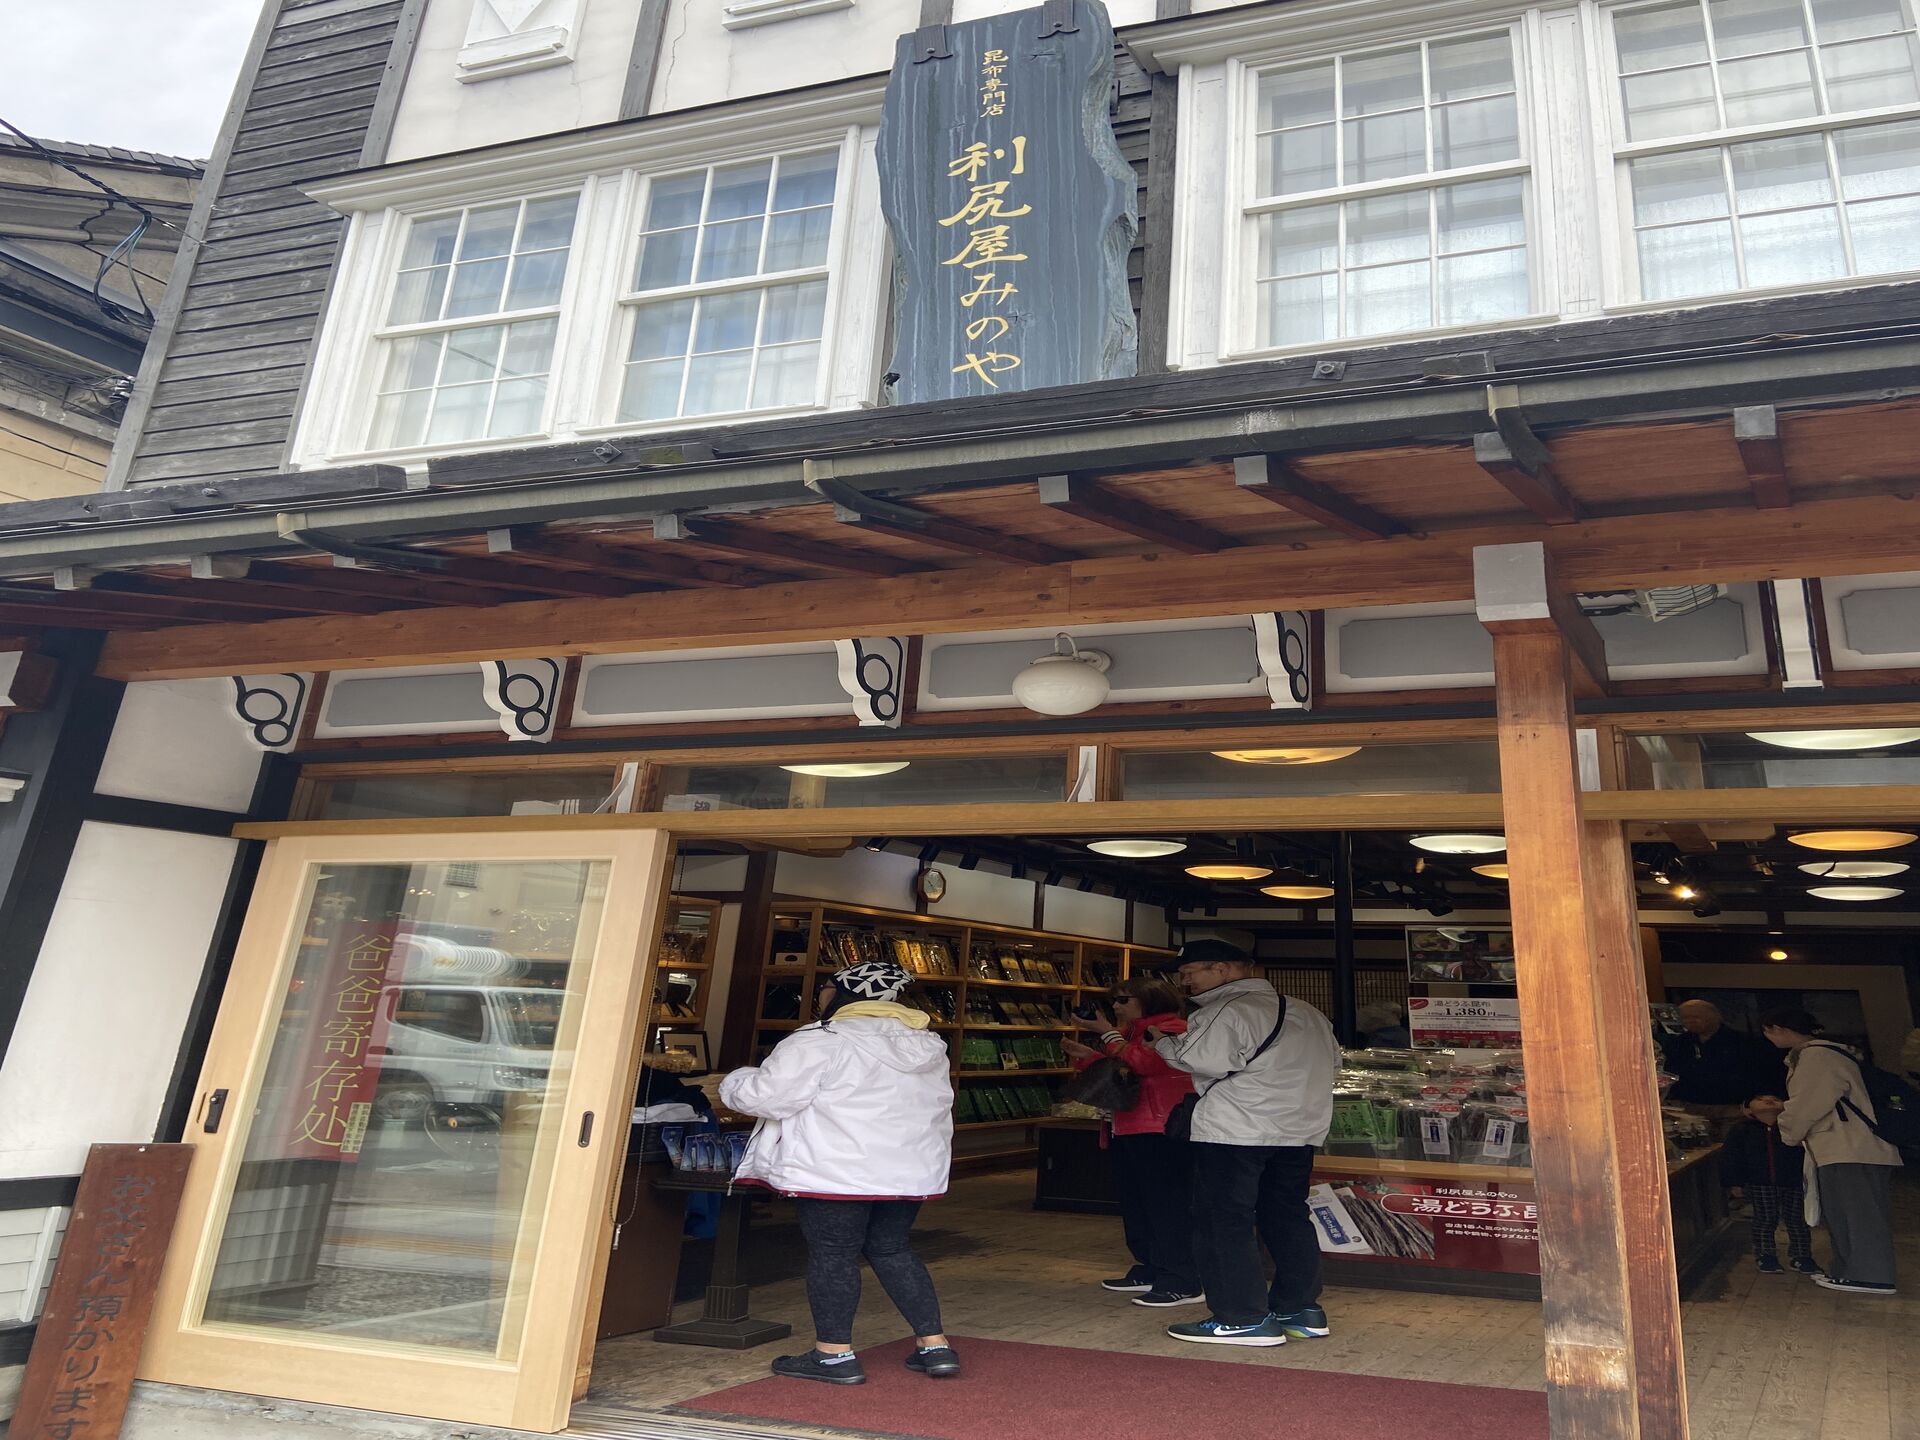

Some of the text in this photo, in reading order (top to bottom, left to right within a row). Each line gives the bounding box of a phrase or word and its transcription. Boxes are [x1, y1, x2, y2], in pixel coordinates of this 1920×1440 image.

[938, 136, 1032, 388] 利尻屋みのや
[288, 934, 394, 1147] 爸爸寄存处
[44, 1173, 157, 1440] お父さん預かります
[1435, 1187, 1518, 1198] 利尻屋みのやの
